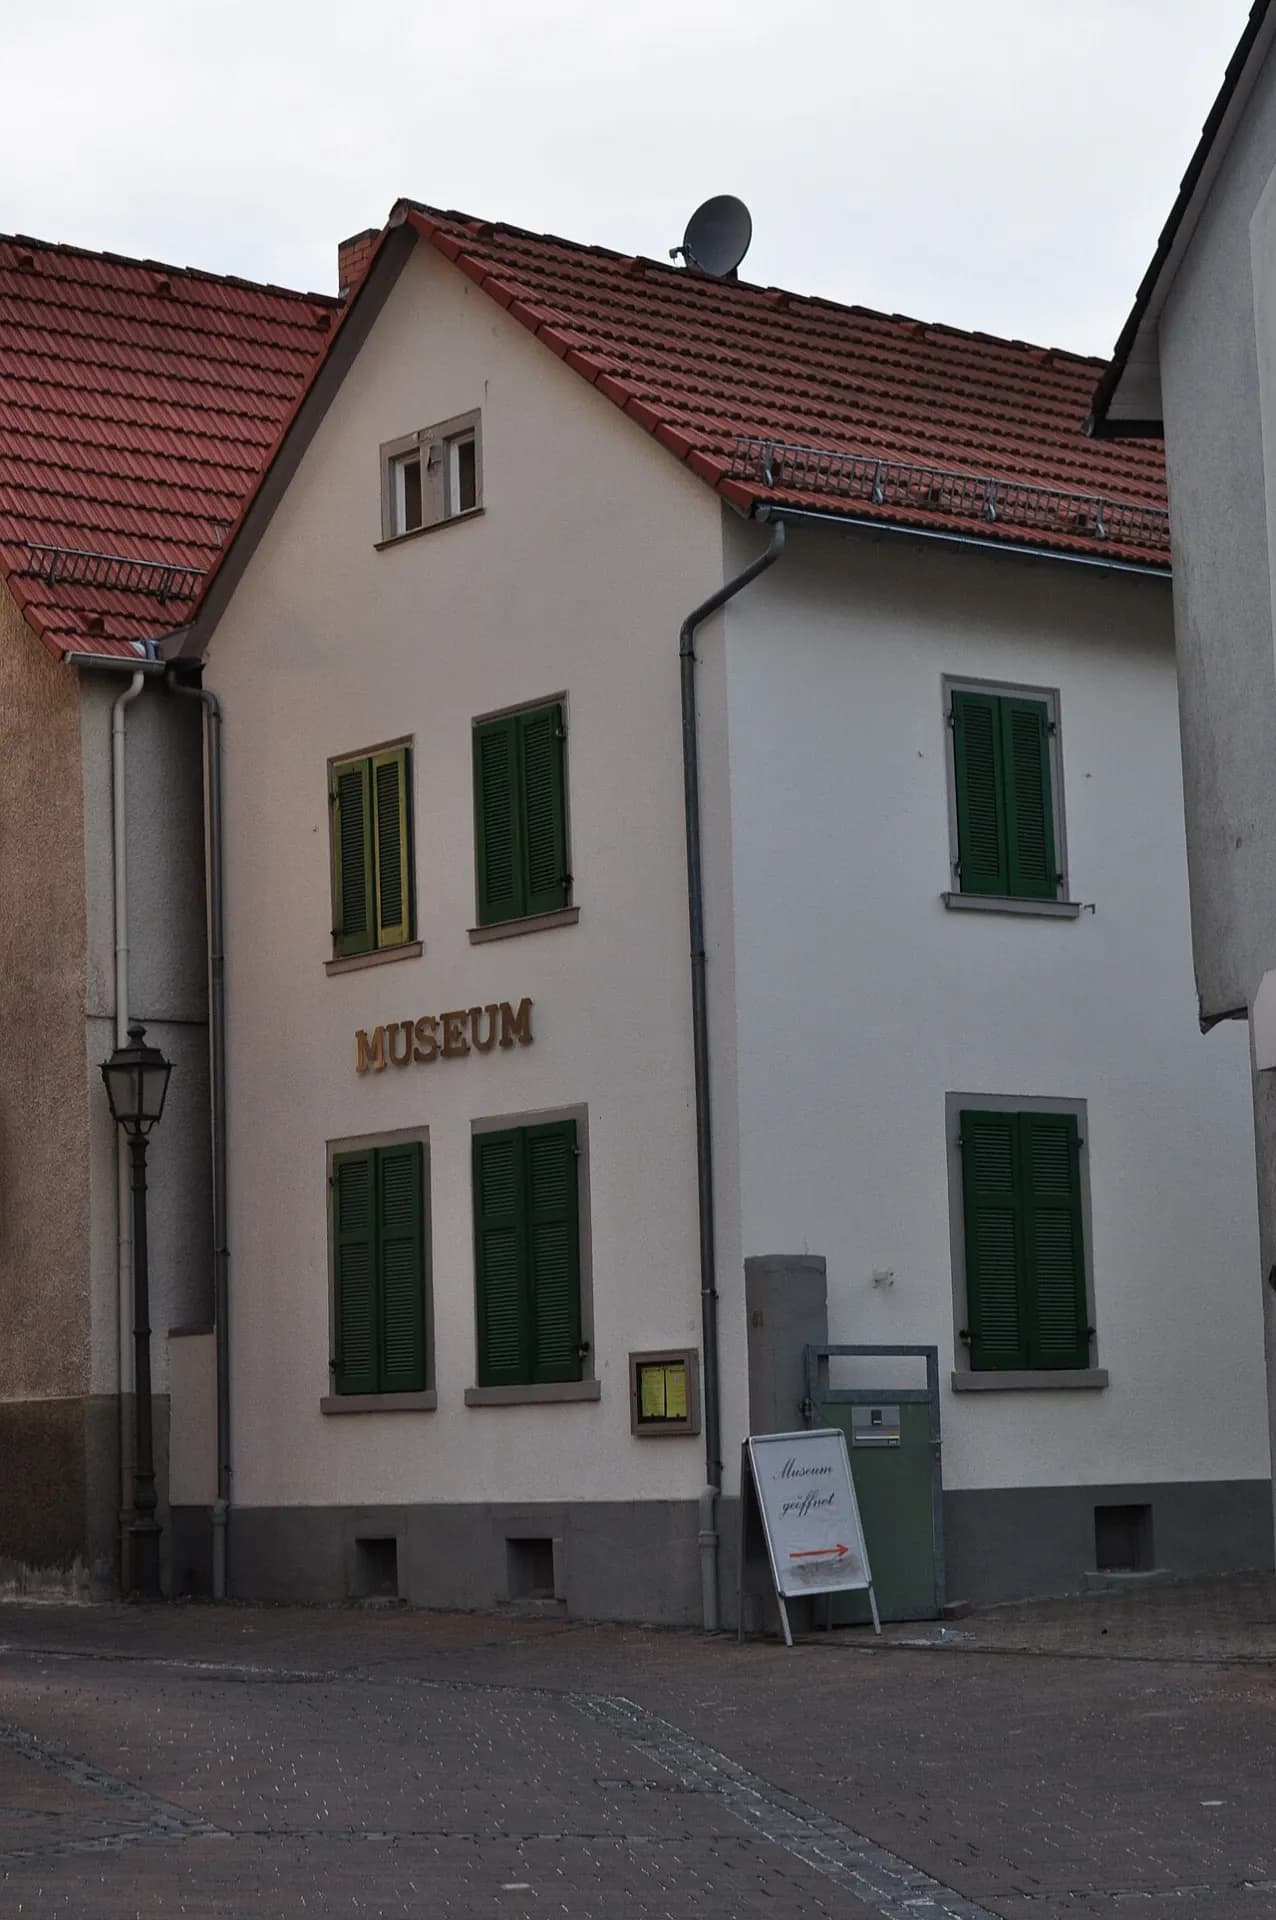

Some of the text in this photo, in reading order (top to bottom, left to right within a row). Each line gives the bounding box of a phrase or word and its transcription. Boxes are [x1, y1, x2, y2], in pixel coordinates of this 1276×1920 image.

[355, 997, 533, 1073] MUSEUM
[772, 1457, 832, 1480] Museum
[779, 1492, 835, 1520] geöffnet
